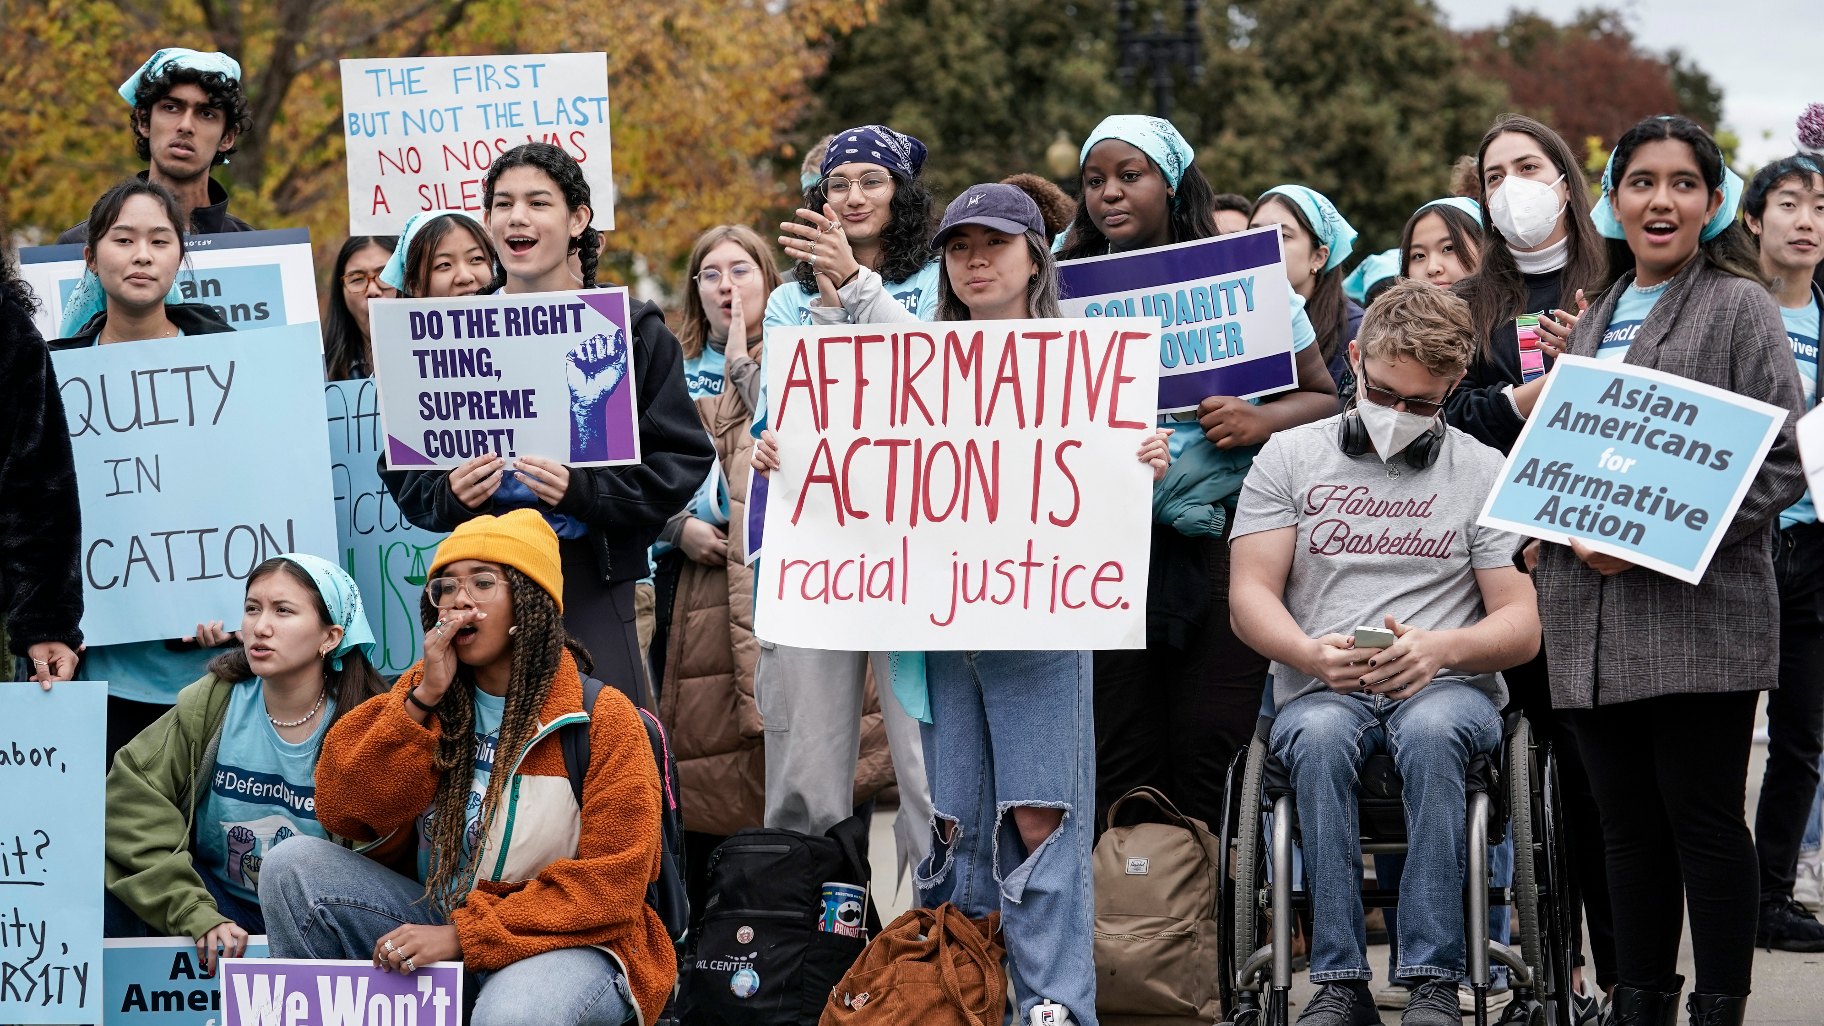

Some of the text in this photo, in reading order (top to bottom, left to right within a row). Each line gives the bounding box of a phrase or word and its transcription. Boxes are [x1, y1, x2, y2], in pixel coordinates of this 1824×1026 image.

[365, 63, 546, 97] THE FIRST
[348, 96, 608, 137] BUT NOT THE LAST
[378, 146, 422, 176] NO
[372, 179, 487, 216] A SILE
[410, 303, 586, 340] DO THE RIGHT
[413, 347, 502, 382] THING,
[775, 329, 1152, 435] AFFIRMATIVE
[60, 361, 235, 437] QUITY
[418, 388, 538, 420] SUPREME
[1597, 378, 1699, 427] Asian
[423, 428, 516, 459] COURT!
[1546, 401, 1734, 471] Americans
[104, 454, 161, 497] IN
[1598, 447, 1636, 474] for
[790, 437, 1083, 529] ACTION IS
[1303, 484, 1438, 518] Harvard
[1513, 457, 1709, 531] Affirmative
[1309, 518, 1457, 559] Basketball
[1533, 495, 1646, 546] Action
[777, 535, 1131, 627] racial justice.
[169, 951, 224, 980] As
[232, 973, 452, 1026] We Won't
